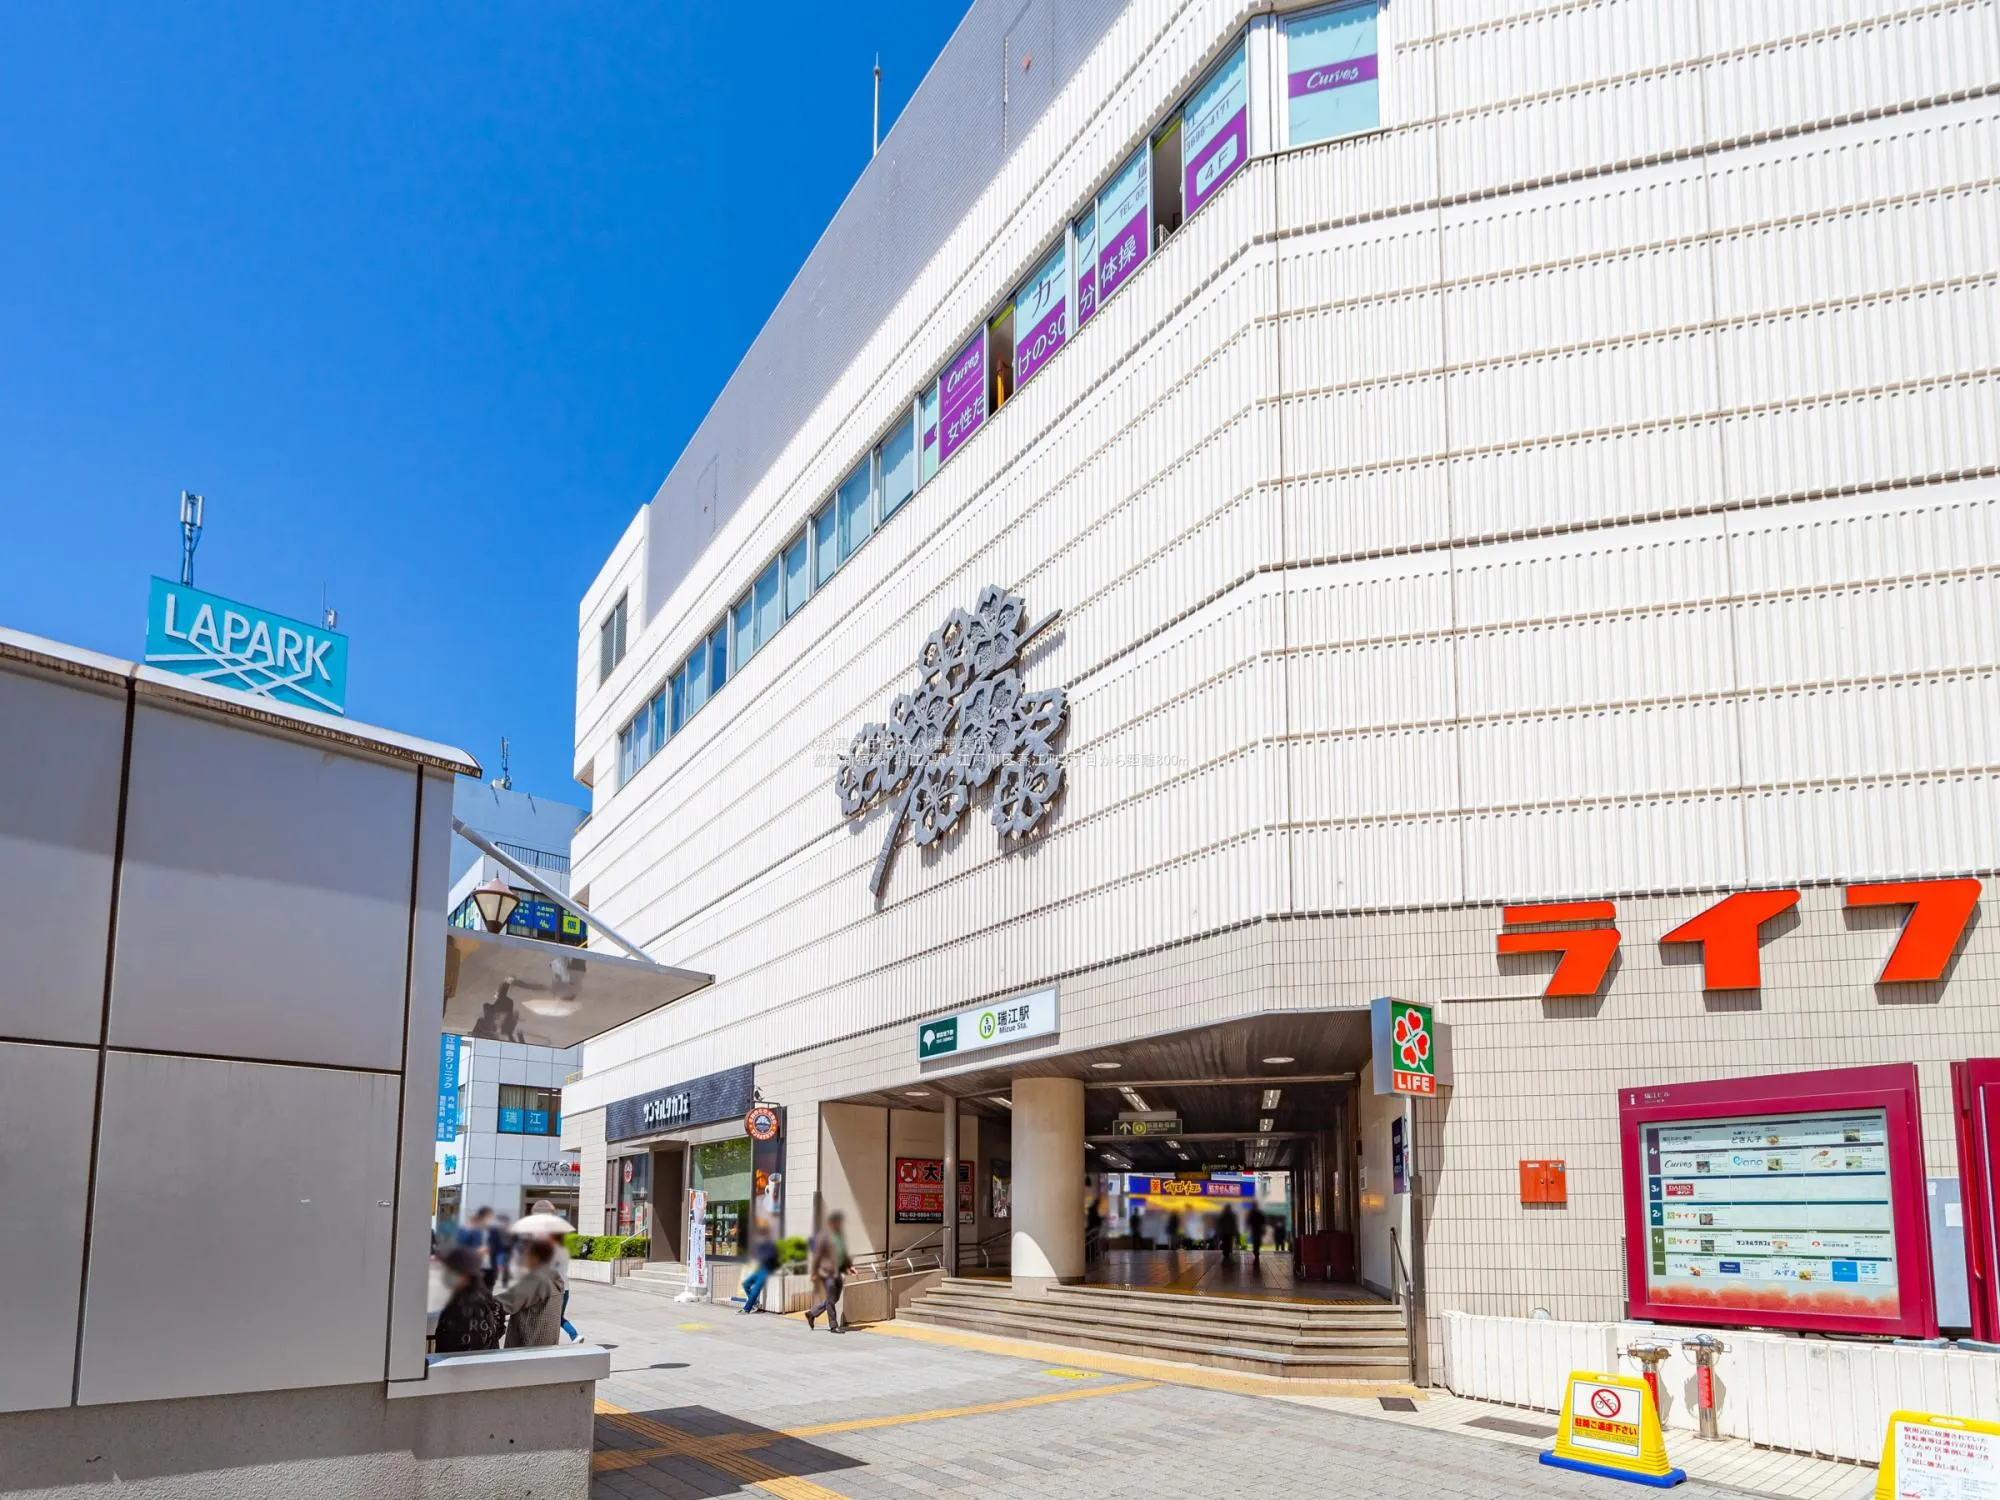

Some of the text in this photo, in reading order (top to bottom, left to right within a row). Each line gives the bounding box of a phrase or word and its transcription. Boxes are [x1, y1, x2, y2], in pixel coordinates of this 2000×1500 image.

[1306, 67, 1359, 89] Curves
[947, 352, 980, 393] Curves
[165, 593, 331, 681] LAPARK
[1497, 879, 1982, 997] ライフ
[998, 1004, 1030, 1026] 瑞江駅
[983, 1024, 992, 1034] 19
[999, 1022, 1029, 1034] Mizue Sta.
[1397, 1074, 1430, 1092] LIFE
[643, 1093, 689, 1123] サンマルクカフェ
[1575, 1417, 1638, 1436] 駐輪ご遠慮下さい
